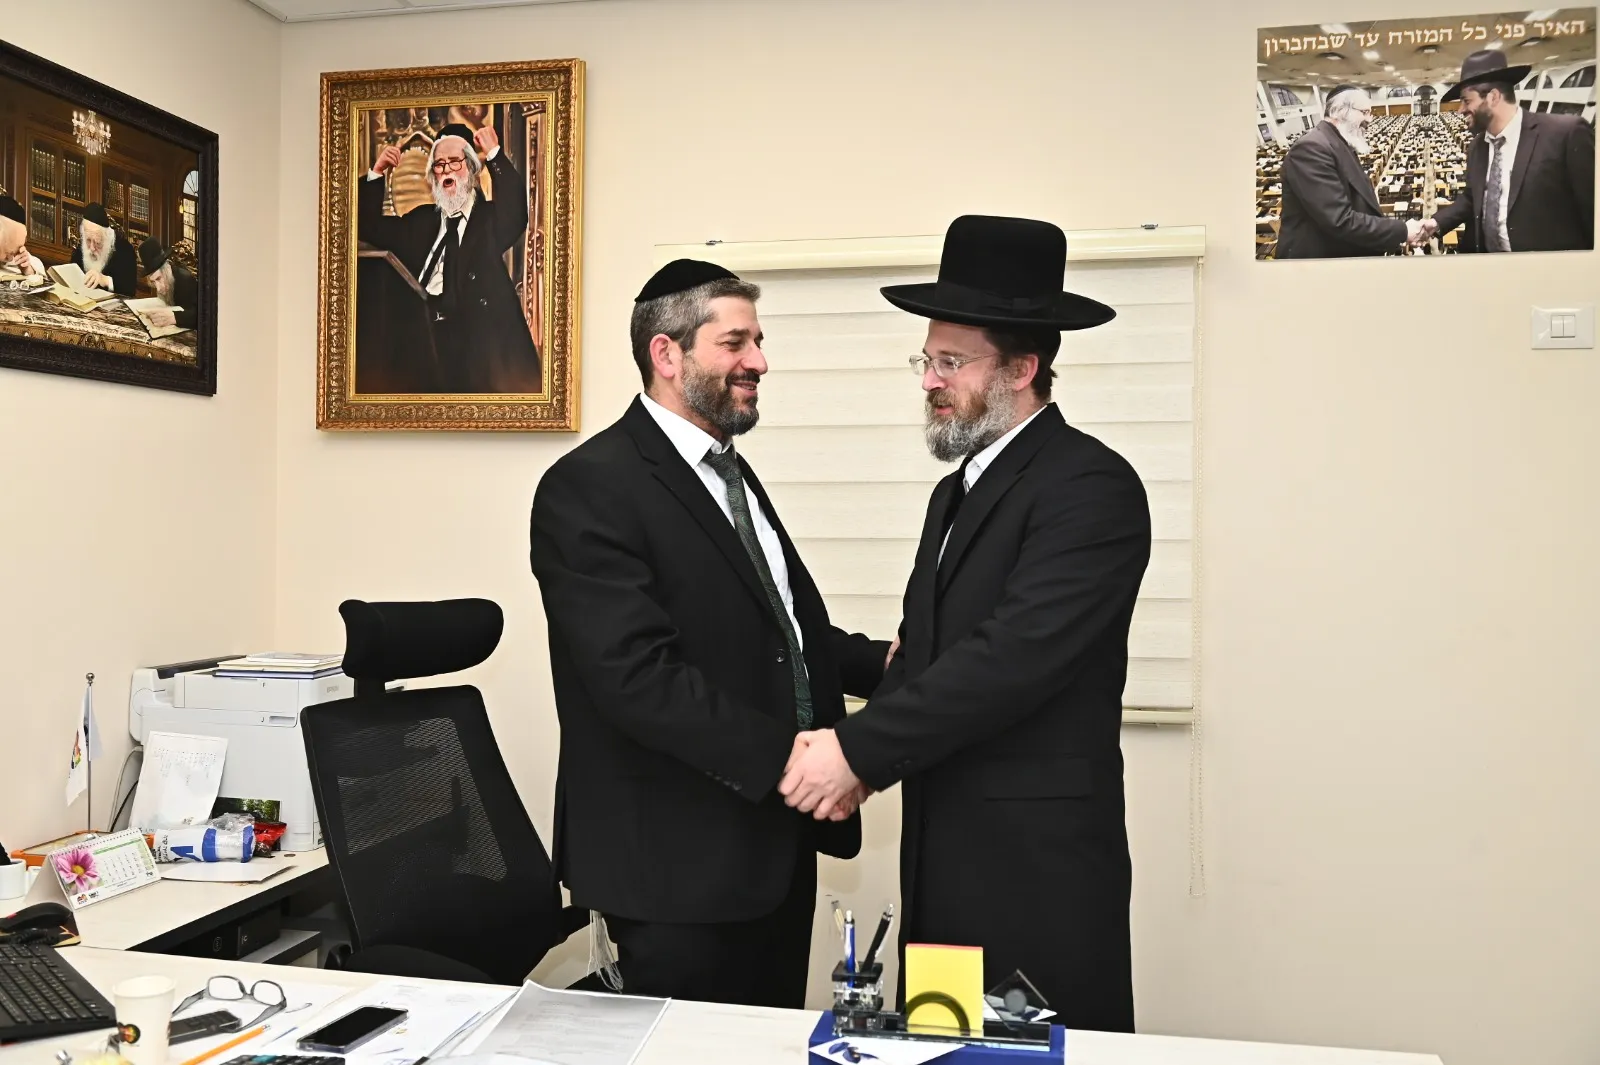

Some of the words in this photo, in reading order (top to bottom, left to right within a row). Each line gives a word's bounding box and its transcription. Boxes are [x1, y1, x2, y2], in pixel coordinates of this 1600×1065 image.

[1388, 27, 1453, 47] המזרח
[1461, 21, 1487, 41] כל
[1495, 23, 1526, 39] פני
[1533, 20, 1586, 36] האיר
[1264, 33, 1347, 58] שבחברון
[1354, 32, 1380, 48] עד
